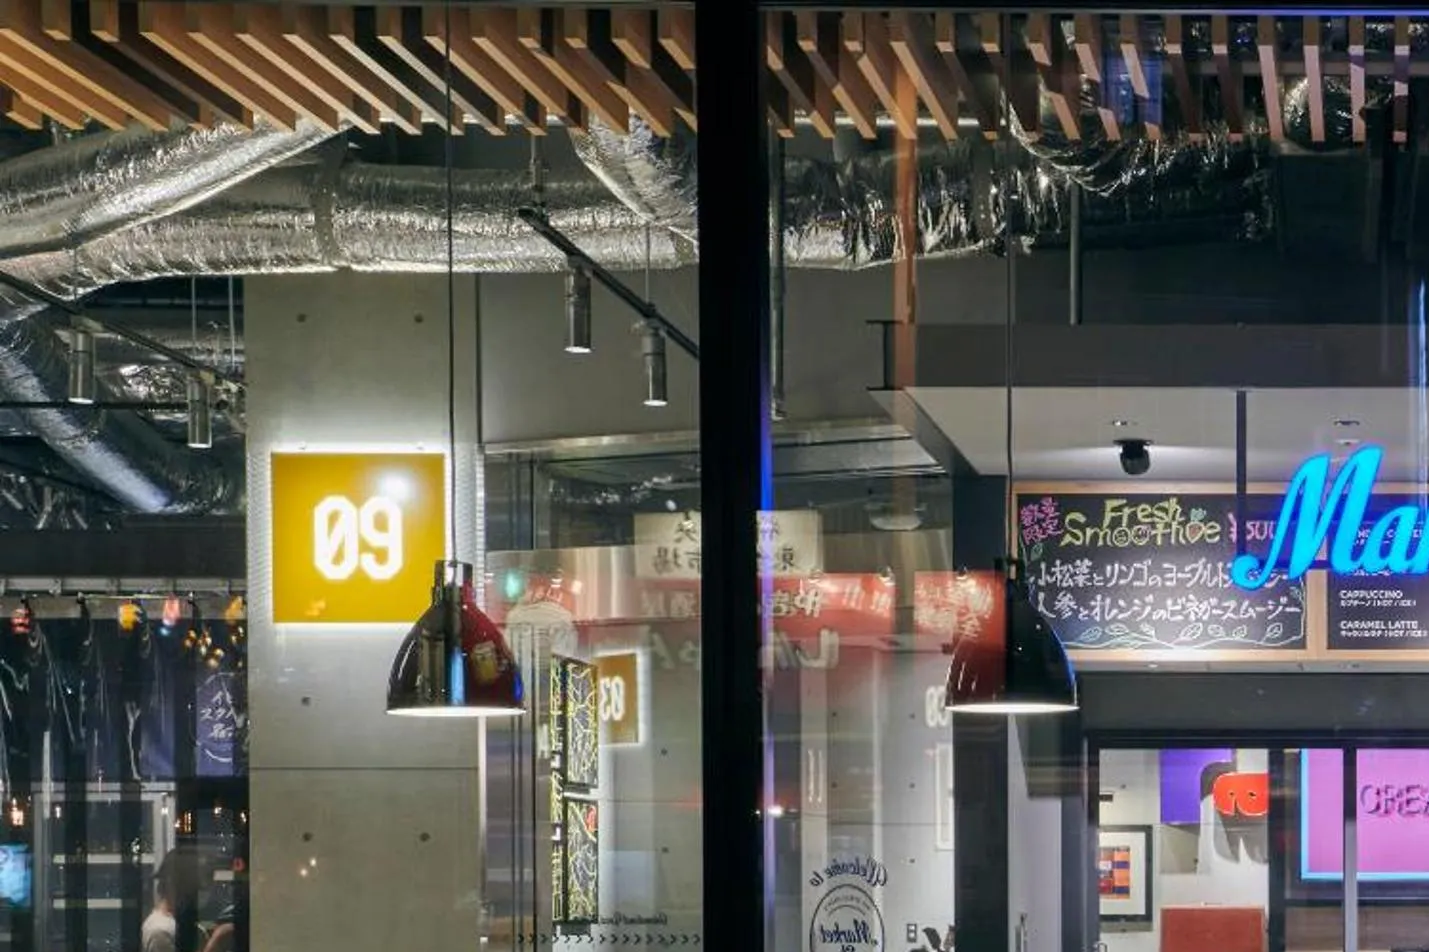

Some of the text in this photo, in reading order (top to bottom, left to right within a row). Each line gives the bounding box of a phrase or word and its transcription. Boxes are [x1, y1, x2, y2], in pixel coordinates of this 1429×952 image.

[1103, 498, 1182, 531] Fresh
[313, 494, 404, 580] 09
[1339, 589, 1403, 599] CAPPUCCINO
[1339, 620, 1387, 630] CARAMEL
[1388, 620, 1419, 630] LATTE
